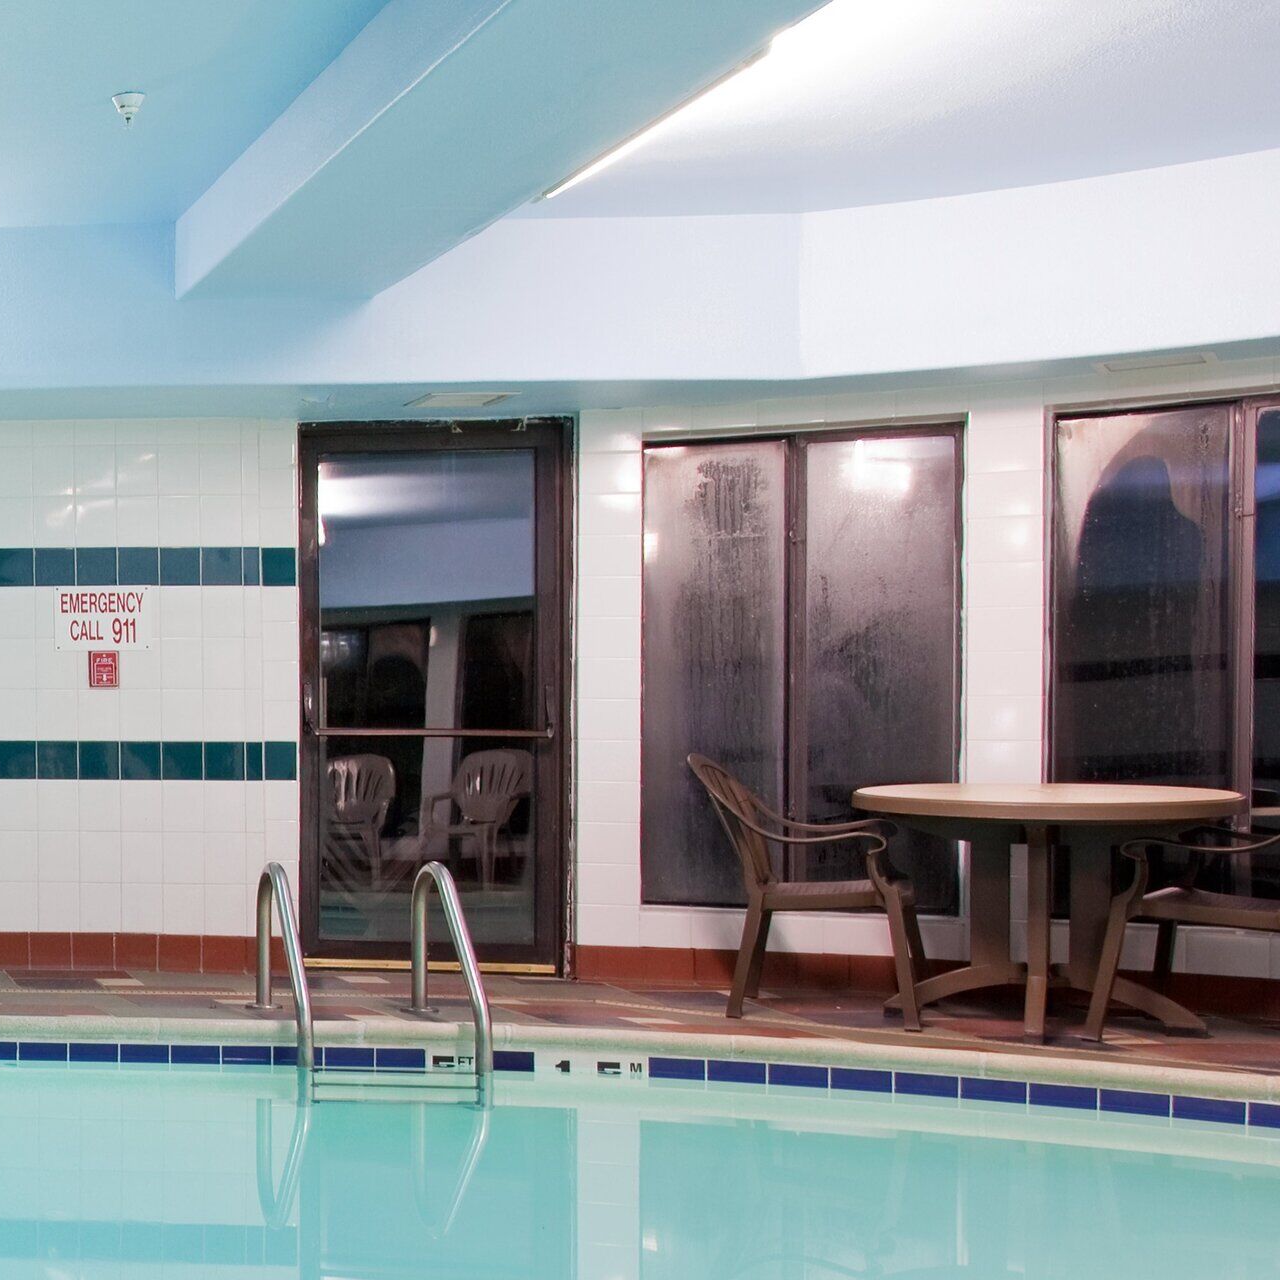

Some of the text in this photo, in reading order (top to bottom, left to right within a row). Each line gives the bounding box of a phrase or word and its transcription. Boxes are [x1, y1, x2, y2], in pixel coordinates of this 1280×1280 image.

[60, 592, 144, 613] EMERGENCY
[70, 617, 136, 644] CALL 911
[458, 1056, 474, 1066] FT
[630, 1062, 642, 1073] M
